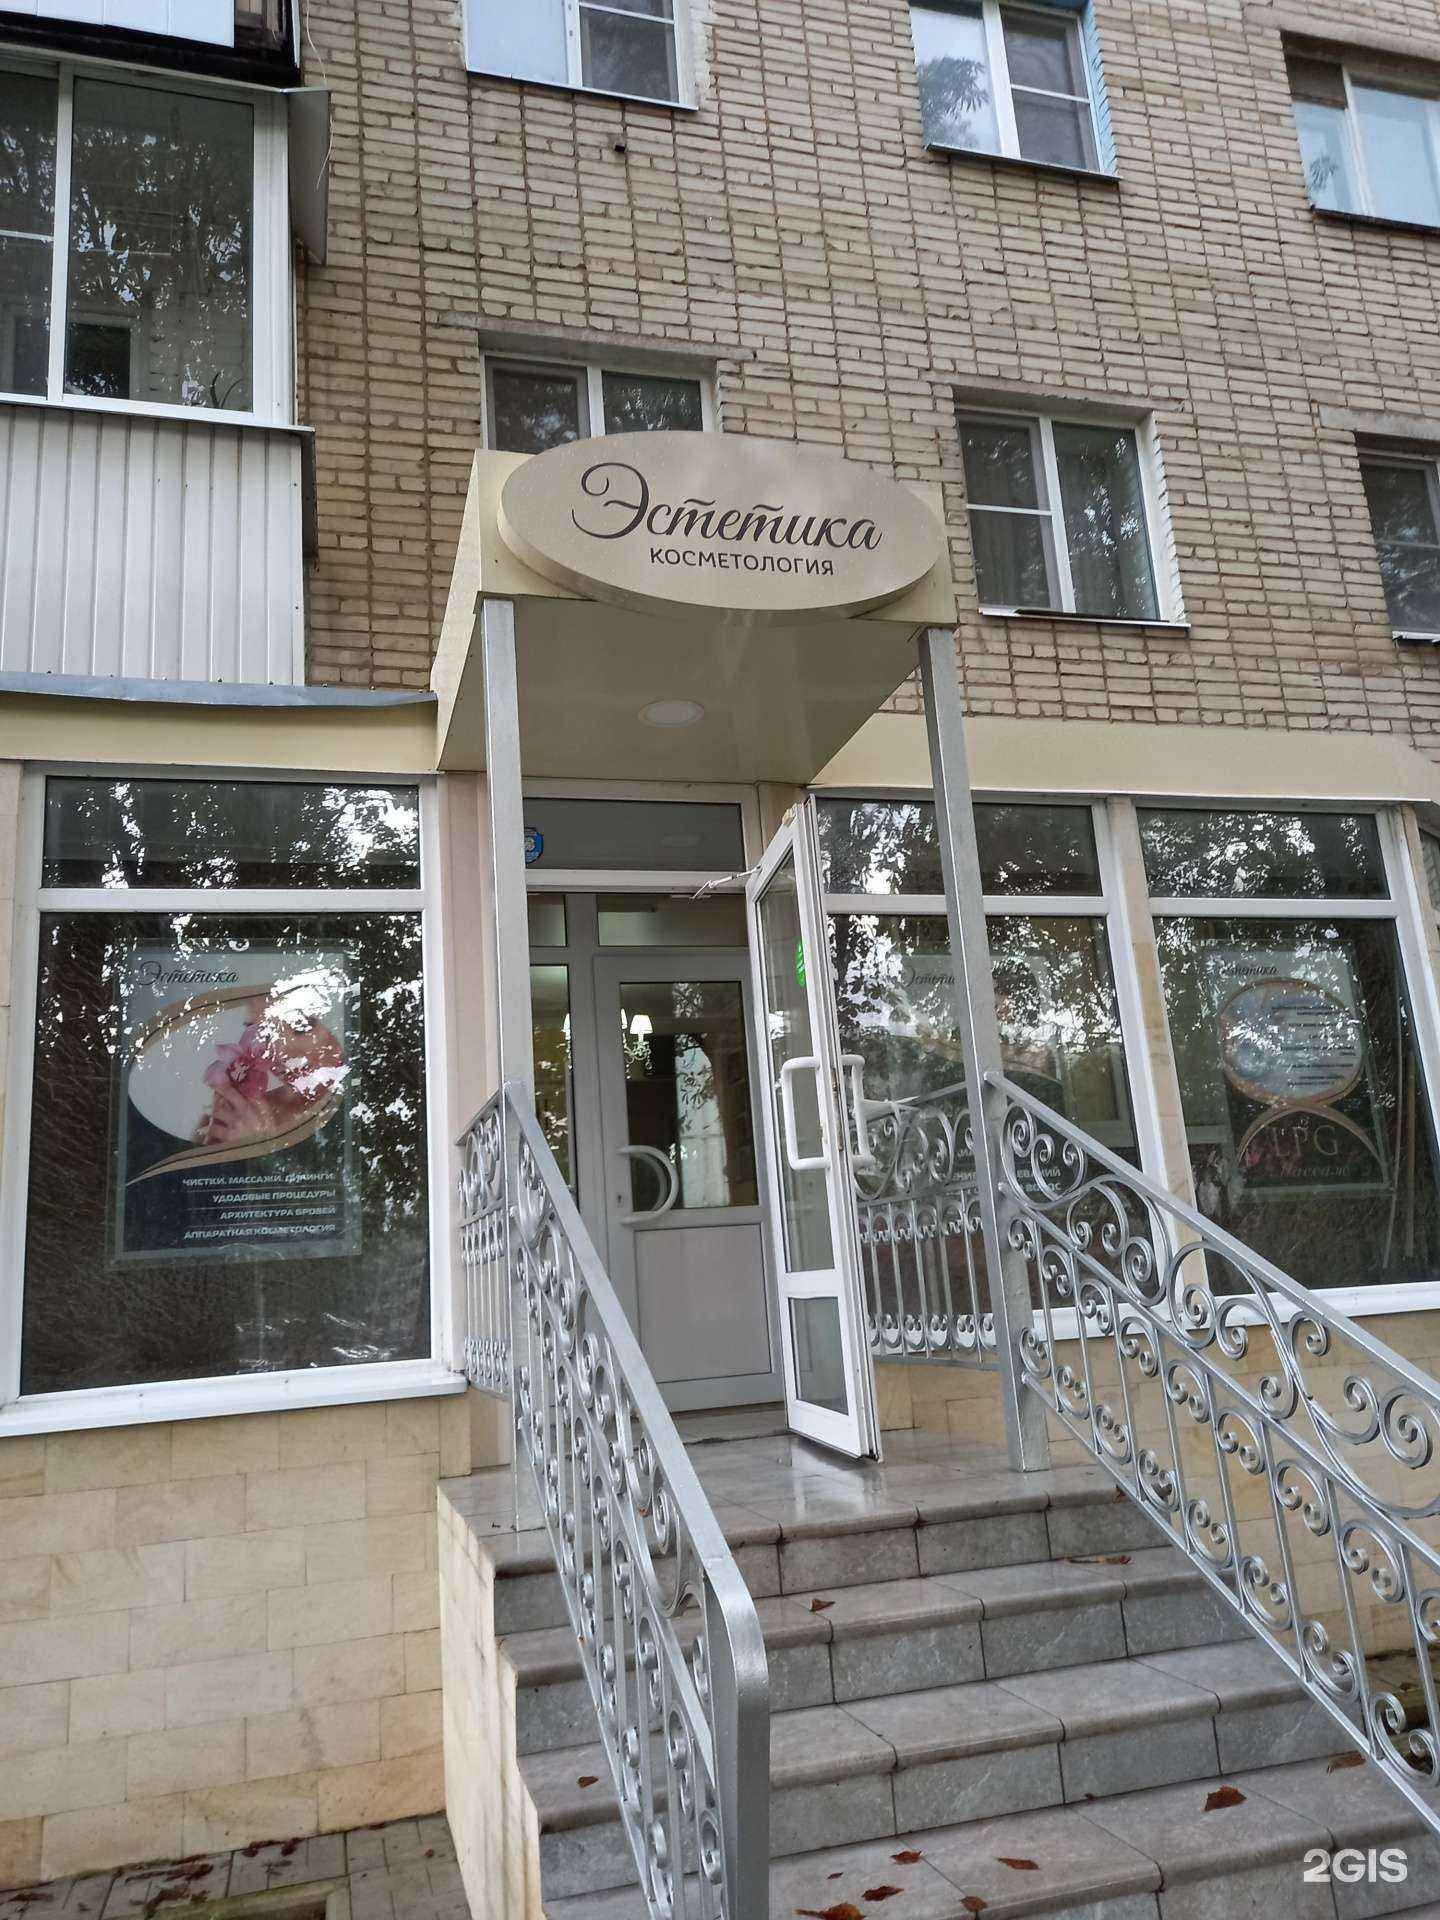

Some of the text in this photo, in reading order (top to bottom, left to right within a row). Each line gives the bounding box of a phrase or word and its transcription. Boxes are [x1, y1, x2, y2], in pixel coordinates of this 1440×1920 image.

[571, 461, 884, 551] Эстетика
[650, 546, 835, 576] КОСМЕТОЛОГИЯ
[219, 1209, 294, 1220] АРХИТЕКТУРА
[183, 1228, 253, 1240] АППАРАТНАЯ
